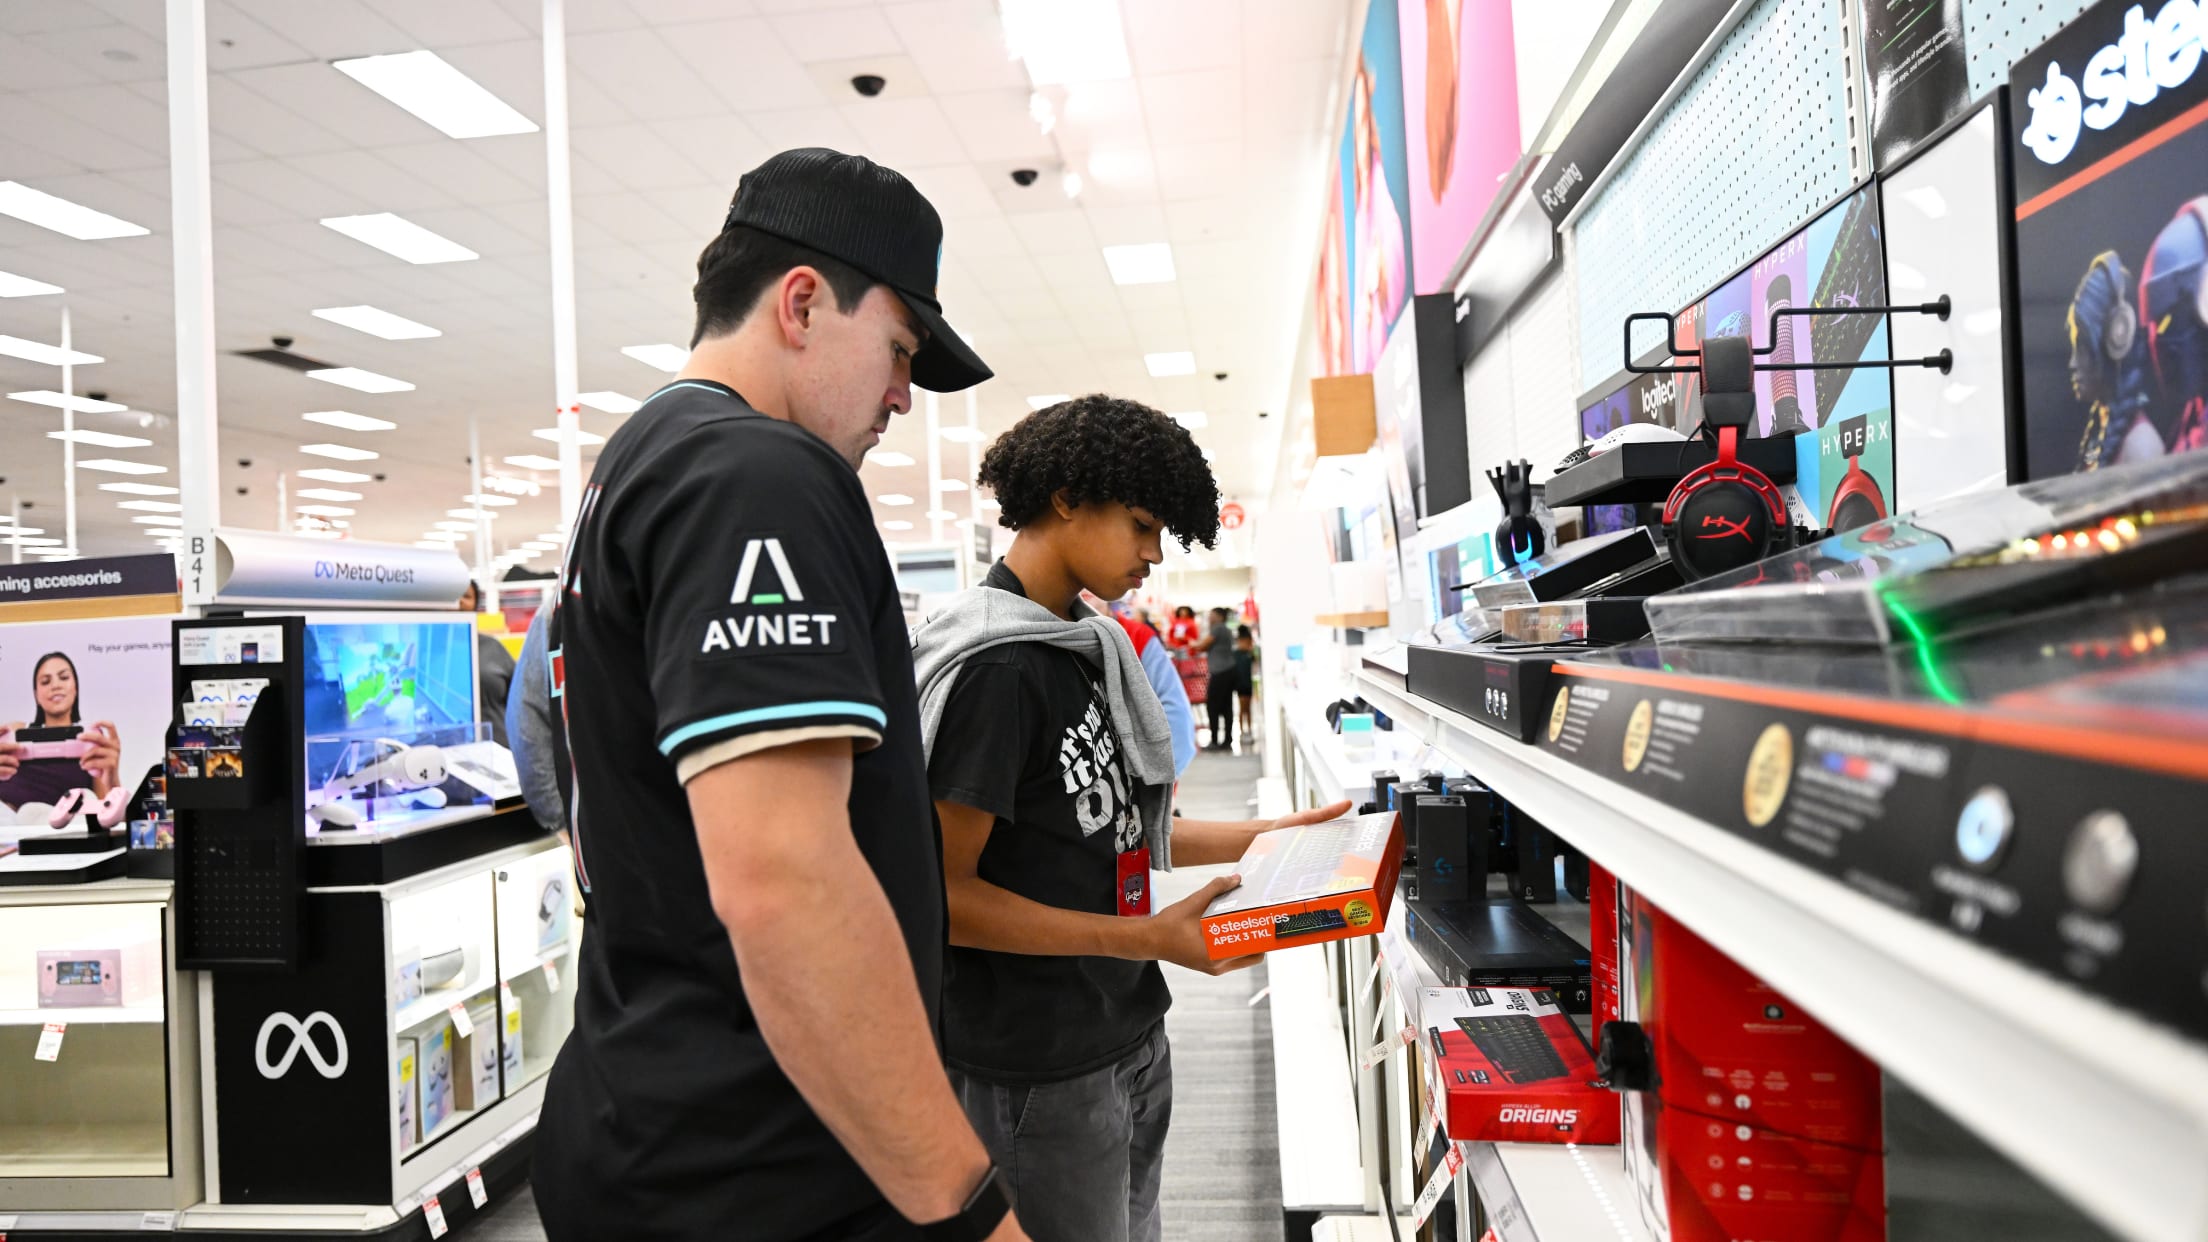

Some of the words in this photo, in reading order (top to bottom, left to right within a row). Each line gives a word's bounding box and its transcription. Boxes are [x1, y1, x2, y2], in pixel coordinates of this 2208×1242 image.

[1541, 188, 1559, 213] PC
[1553, 162, 1583, 203] gaming
[1754, 234, 1805, 280] HYPERX
[1673, 301, 1706, 332] YPERX
[1822, 420, 1889, 456] HYPERX
[34, 569, 122, 589] accessories
[335, 563, 373, 580] Meta
[375, 565, 414, 583] Quest
[702, 614, 837, 653] AVNET
[1221, 913, 1290, 933] steelseries
[1214, 934, 1242, 946] APEX
[1242, 932, 1250, 940] 3
[1251, 929, 1272, 939] TKL
[1500, 1108, 1577, 1124] ORIGINS
